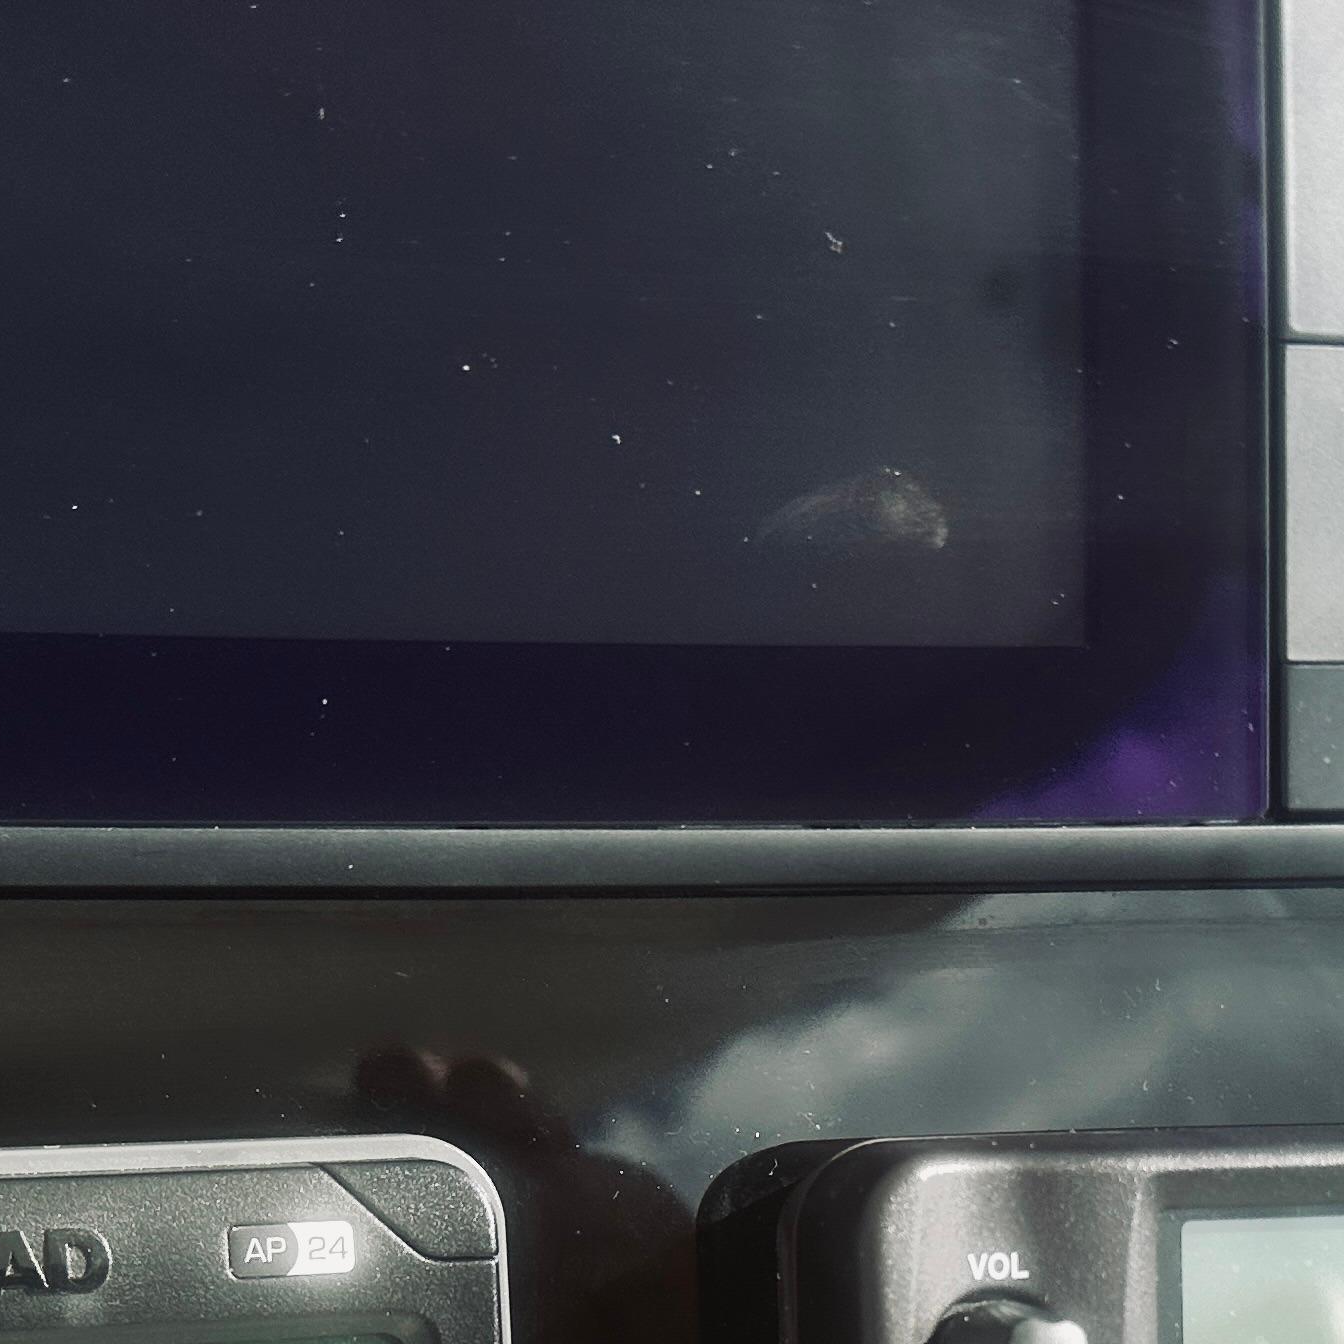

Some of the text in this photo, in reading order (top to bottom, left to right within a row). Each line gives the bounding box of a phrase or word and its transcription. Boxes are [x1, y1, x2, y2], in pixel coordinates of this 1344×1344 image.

[244, 1234, 350, 1264] AP 24
[968, 1252, 1029, 1281] VOL
